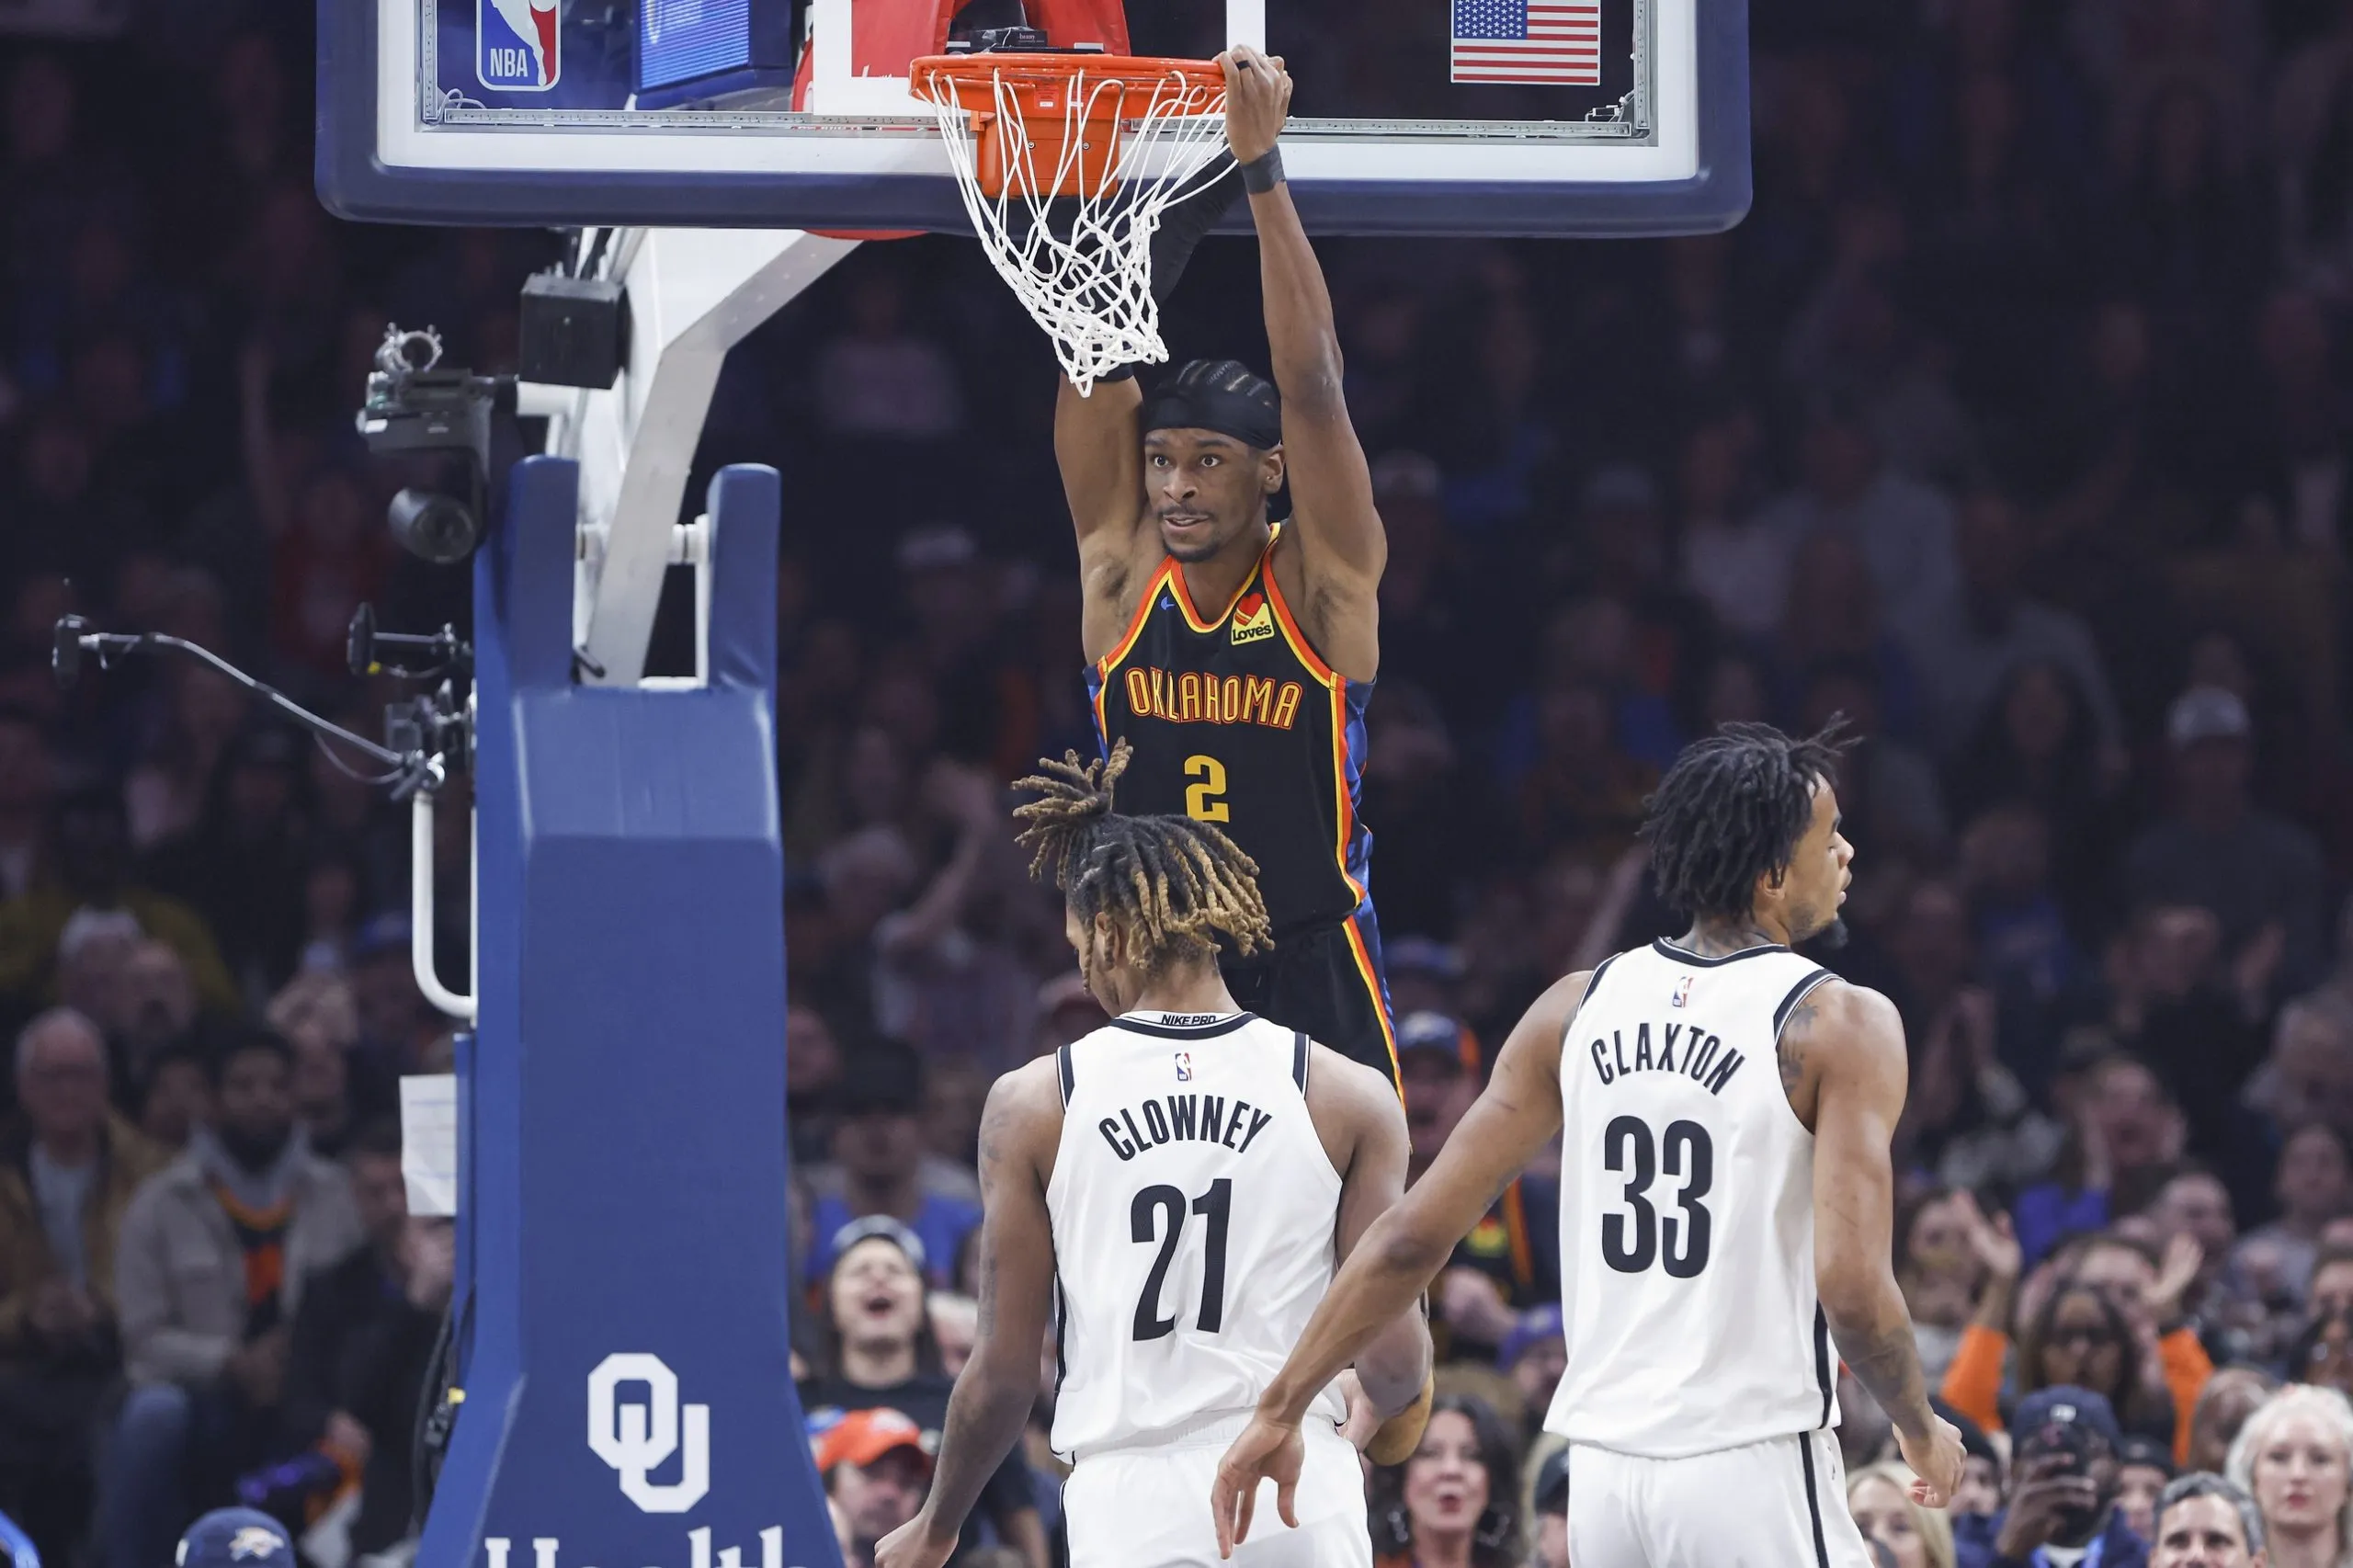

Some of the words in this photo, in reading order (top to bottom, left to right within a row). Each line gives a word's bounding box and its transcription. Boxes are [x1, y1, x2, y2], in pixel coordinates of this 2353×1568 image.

[490, 48, 529, 77] NBA
[1124, 666, 1303, 731] OKLAHOMA
[1184, 755, 1230, 824] 2
[1161, 1014, 1190, 1026] NIKE
[1191, 1015, 1216, 1026] PRO
[1591, 1022, 1745, 1096] CLAXTON
[1098, 1094, 1273, 1162] CLOWNEY
[1601, 1115, 1713, 1279] 33
[1130, 1178, 1233, 1342] 21
[587, 1353, 710, 1513] OU
